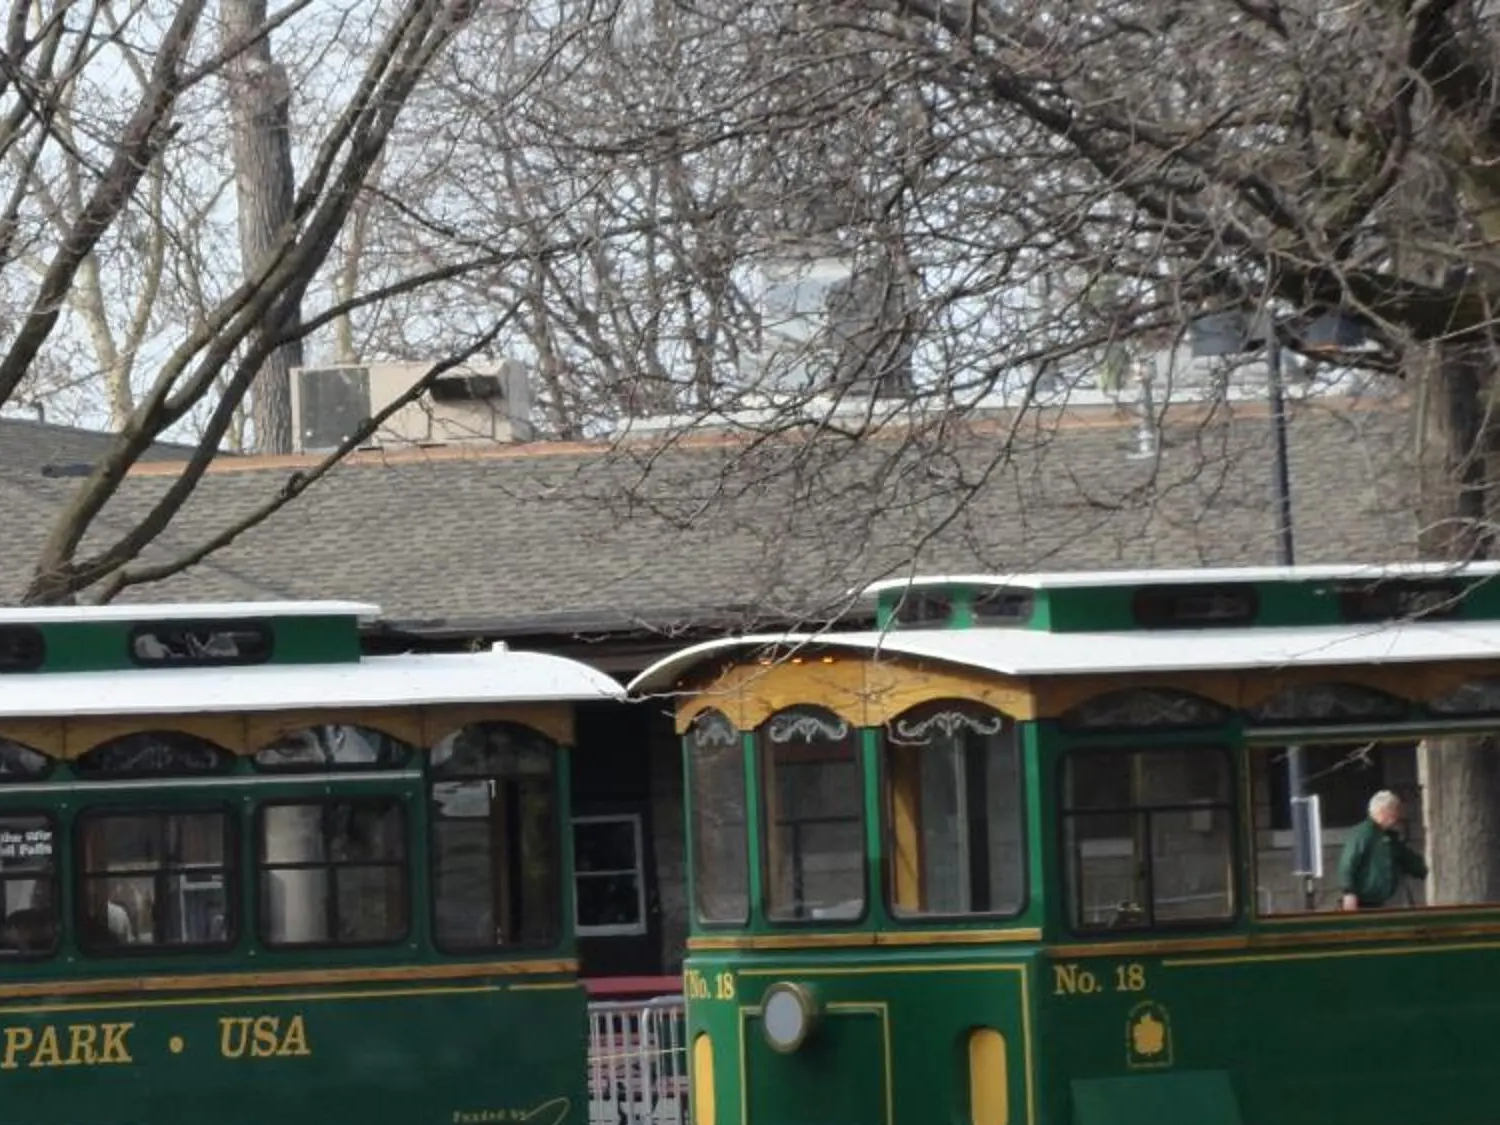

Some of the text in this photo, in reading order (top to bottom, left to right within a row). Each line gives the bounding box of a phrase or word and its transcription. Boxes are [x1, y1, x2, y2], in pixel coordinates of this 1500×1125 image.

[716, 971, 736, 1000] 18
[1053, 963, 1146, 996] No. 18
[0, 1021, 136, 1069] PARK
[218, 1014, 311, 1058] USA
